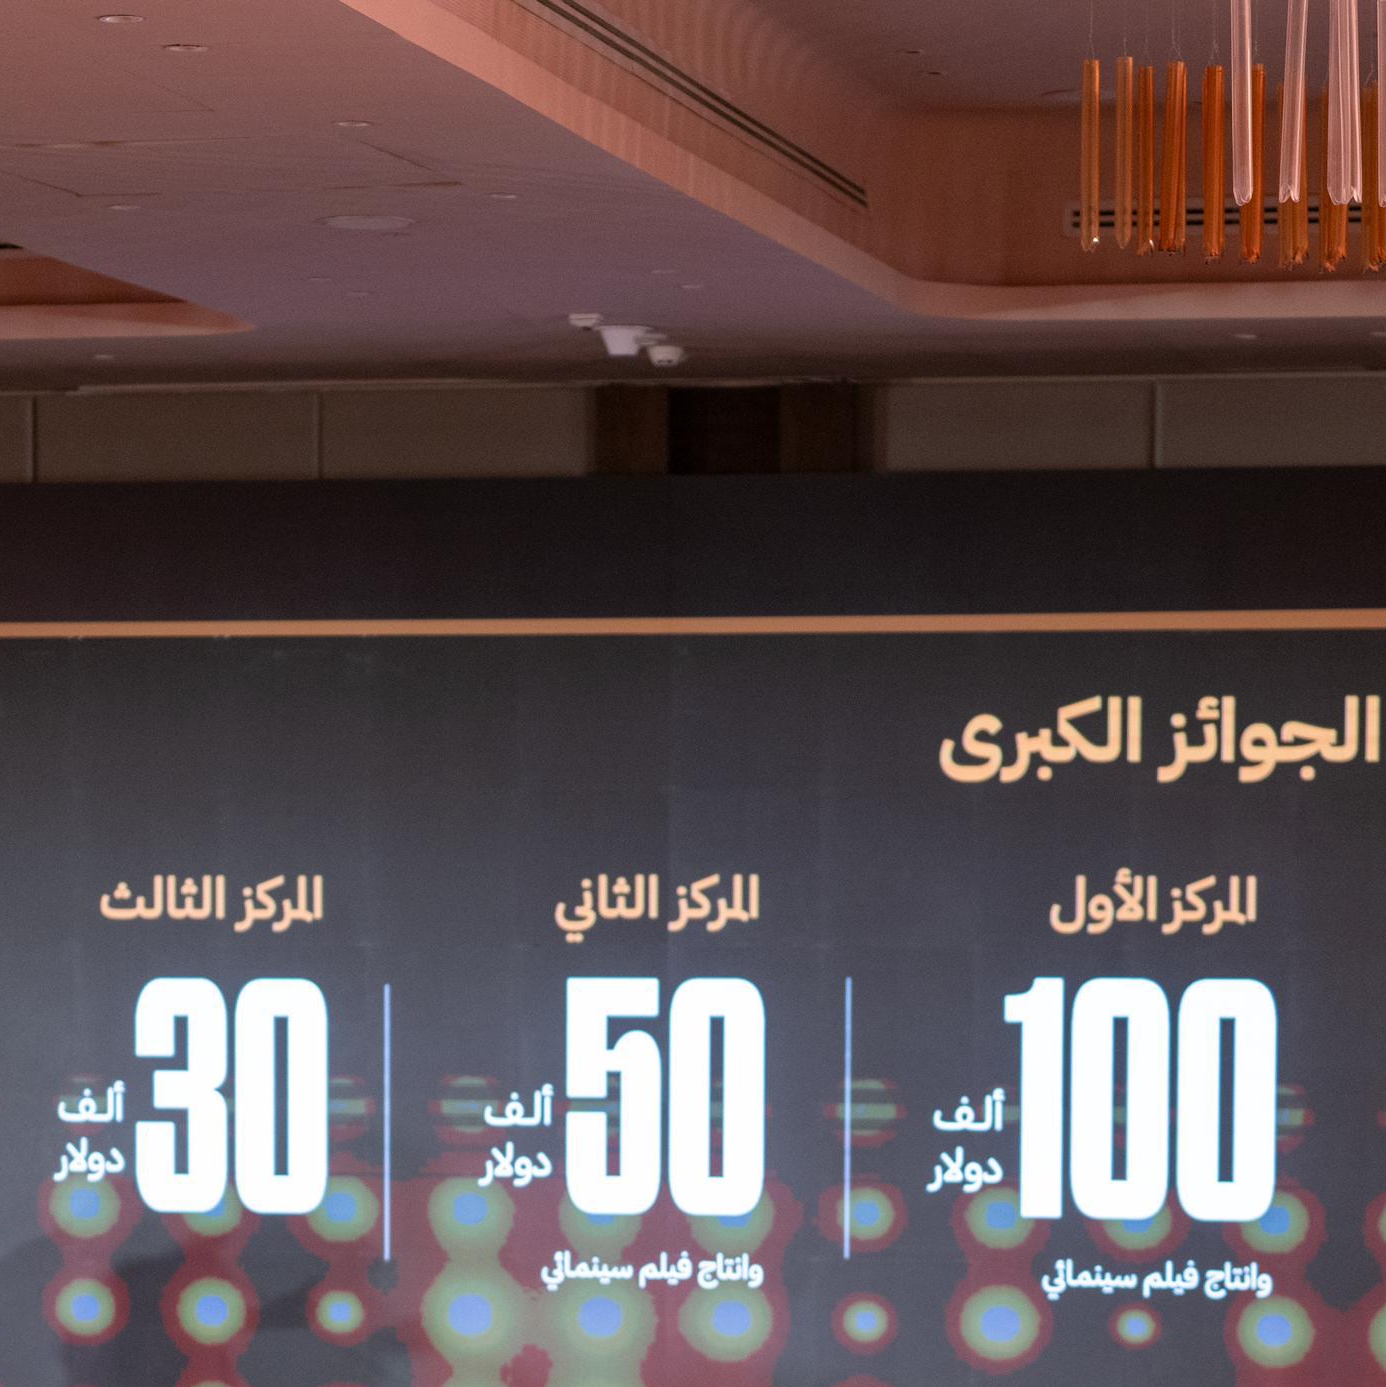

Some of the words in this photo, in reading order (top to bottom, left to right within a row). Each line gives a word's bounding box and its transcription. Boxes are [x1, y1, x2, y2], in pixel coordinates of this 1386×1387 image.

[939, 695, 1142, 783] الكبرى
[1157, 695, 1381, 783] الجوائز
[100, 874, 226, 920] الثالث
[233, 874, 324, 933] المركز
[554, 873, 659, 944] الثاني
[667, 873, 760, 932] المركز
[1049, 867, 1158, 935] الأول
[1161, 875, 1258, 935] المركز
[57, 1080, 126, 1123] ألف
[135, 976, 329, 1215] 30
[484, 1085, 553, 1127] ألف
[565, 976, 766, 1216] 50
[932, 1088, 1004, 1132] ألف
[1003, 976, 1278, 1223] 100
[53, 1137, 125, 1182] دولار
[478, 1143, 553, 1187] دولار
[926, 1147, 1003, 1192] دولار
[540, 1249, 634, 1291] سينمائي
[638, 1250, 693, 1289] فيلم
[697, 1251, 765, 1289] وانتاج
[1041, 1258, 1138, 1301] سينمائي
[1142, 1260, 1200, 1299] فيلم
[1203, 1261, 1274, 1300] وانتاج
